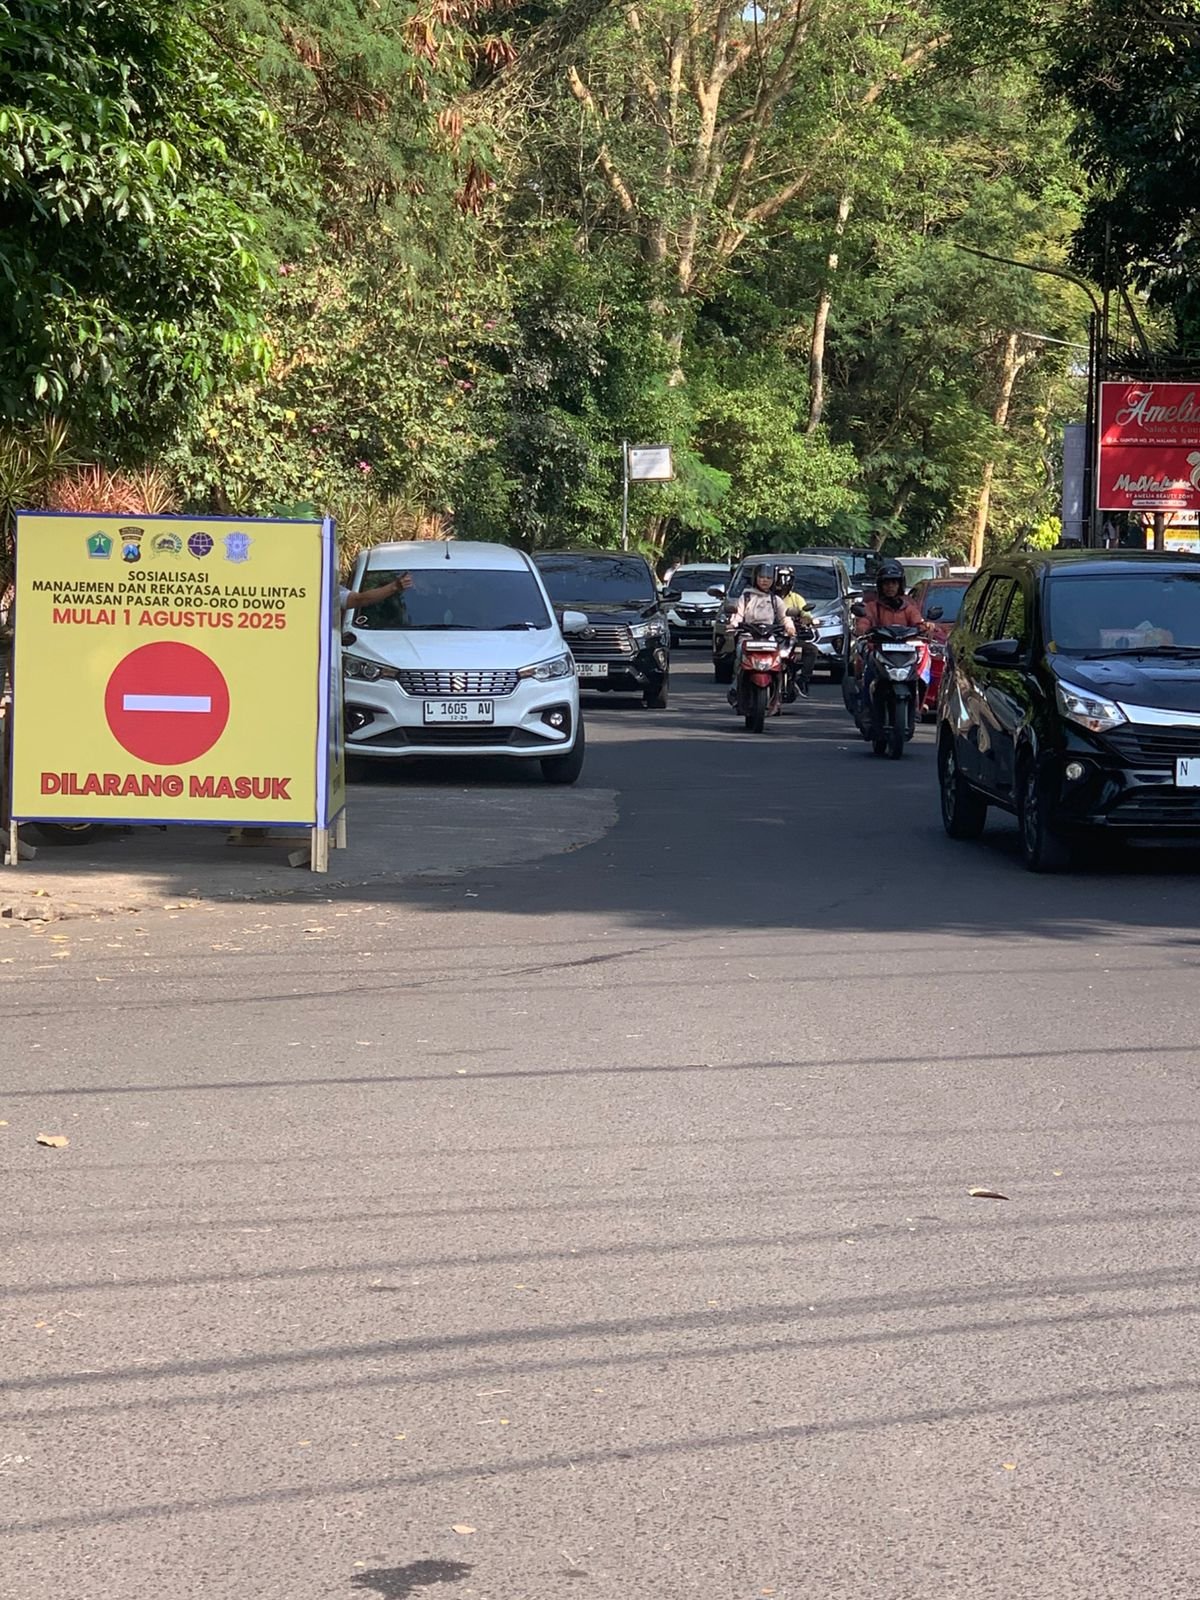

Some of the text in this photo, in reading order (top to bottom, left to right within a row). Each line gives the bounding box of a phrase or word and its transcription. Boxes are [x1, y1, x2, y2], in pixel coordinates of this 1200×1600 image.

[127, 570, 209, 583] SOSIALISASI
[32, 580, 306, 598] MANAJEMEN DAN REKAYASA LALU LINTAS
[53, 593, 286, 610] KAWASAN PASAR ORO-ORO DOWO
[52, 607, 287, 630] MULAI 1 AGUSTUS 2025
[426, 703, 491, 714] L 1605 AV
[1180, 760, 1189, 776] N
[40, 772, 292, 800] DILARANG MASUK
